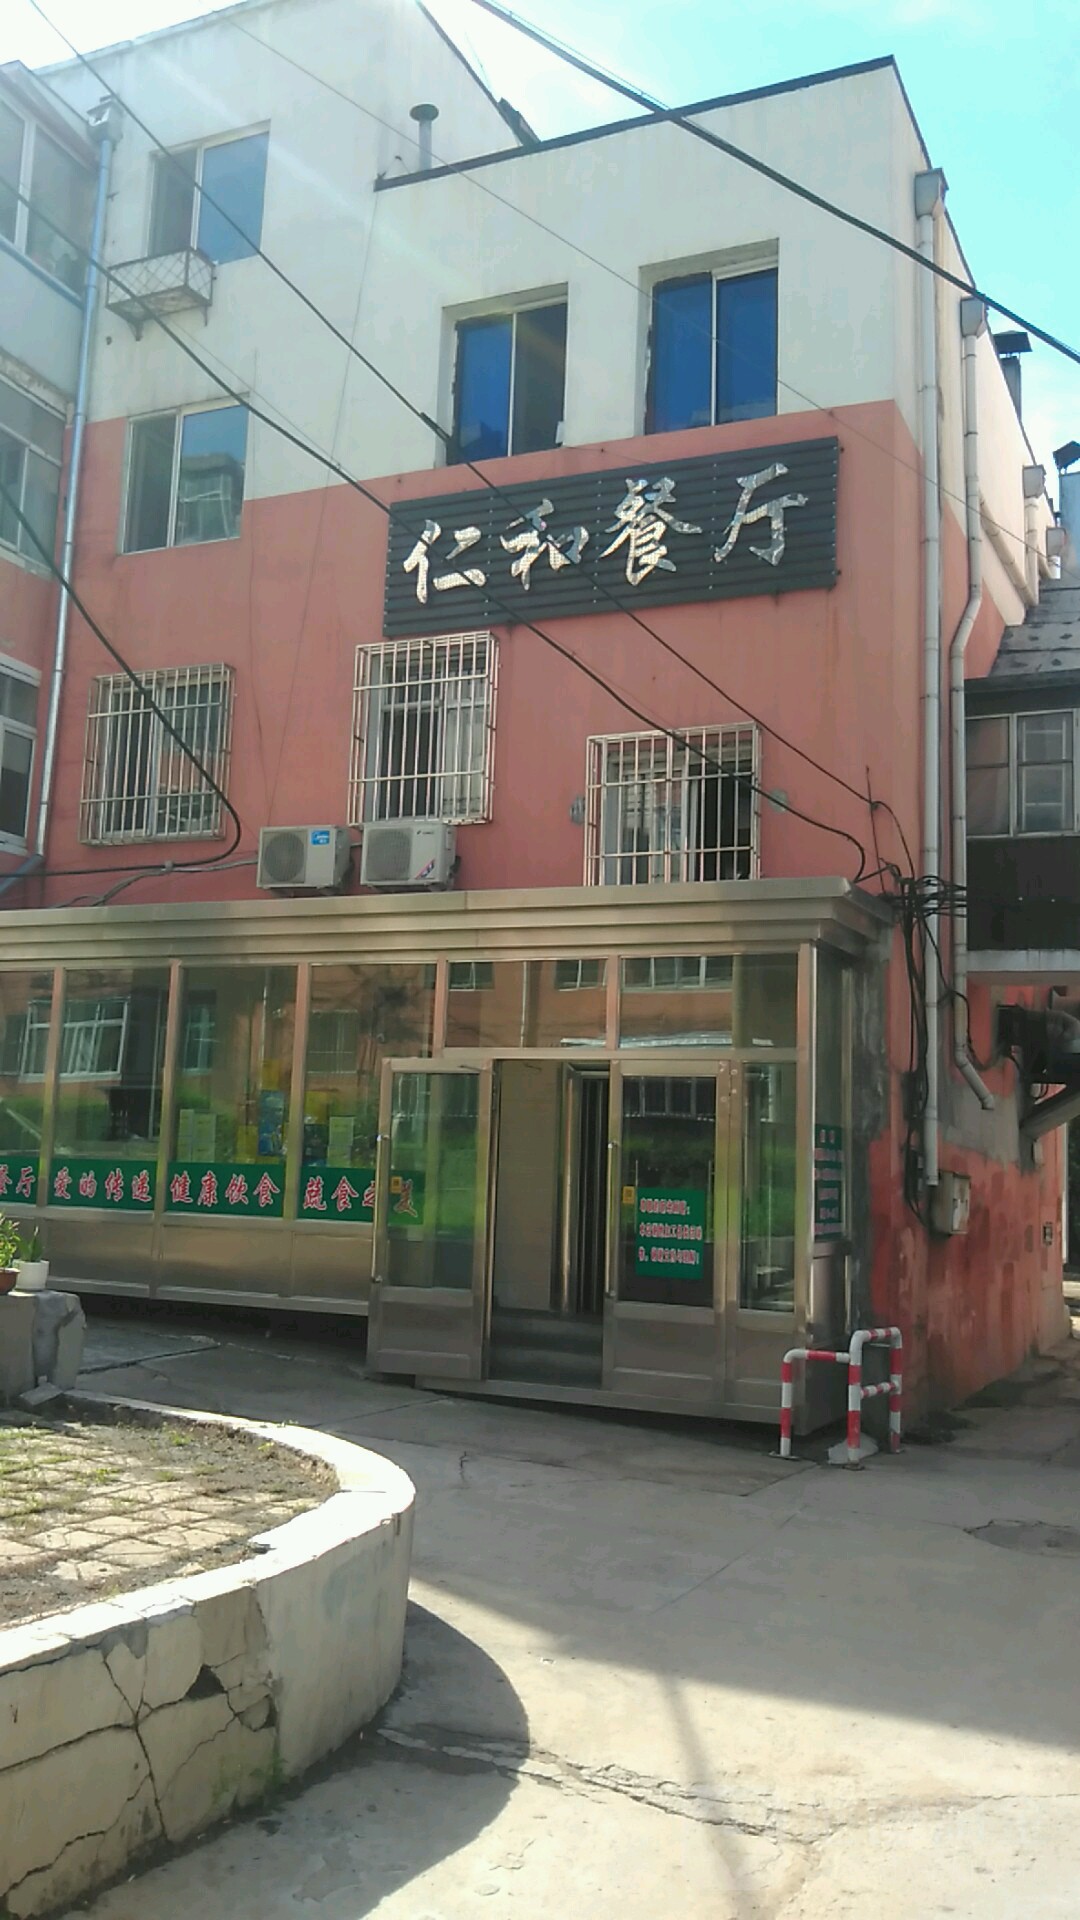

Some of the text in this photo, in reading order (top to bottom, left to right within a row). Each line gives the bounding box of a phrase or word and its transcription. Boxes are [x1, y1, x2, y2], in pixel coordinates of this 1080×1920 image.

[403, 463, 808, 603] 仁和餐厅
[54, 1166, 152, 1202] 爱的传递
[170, 1170, 280, 1207] 健康饮食
